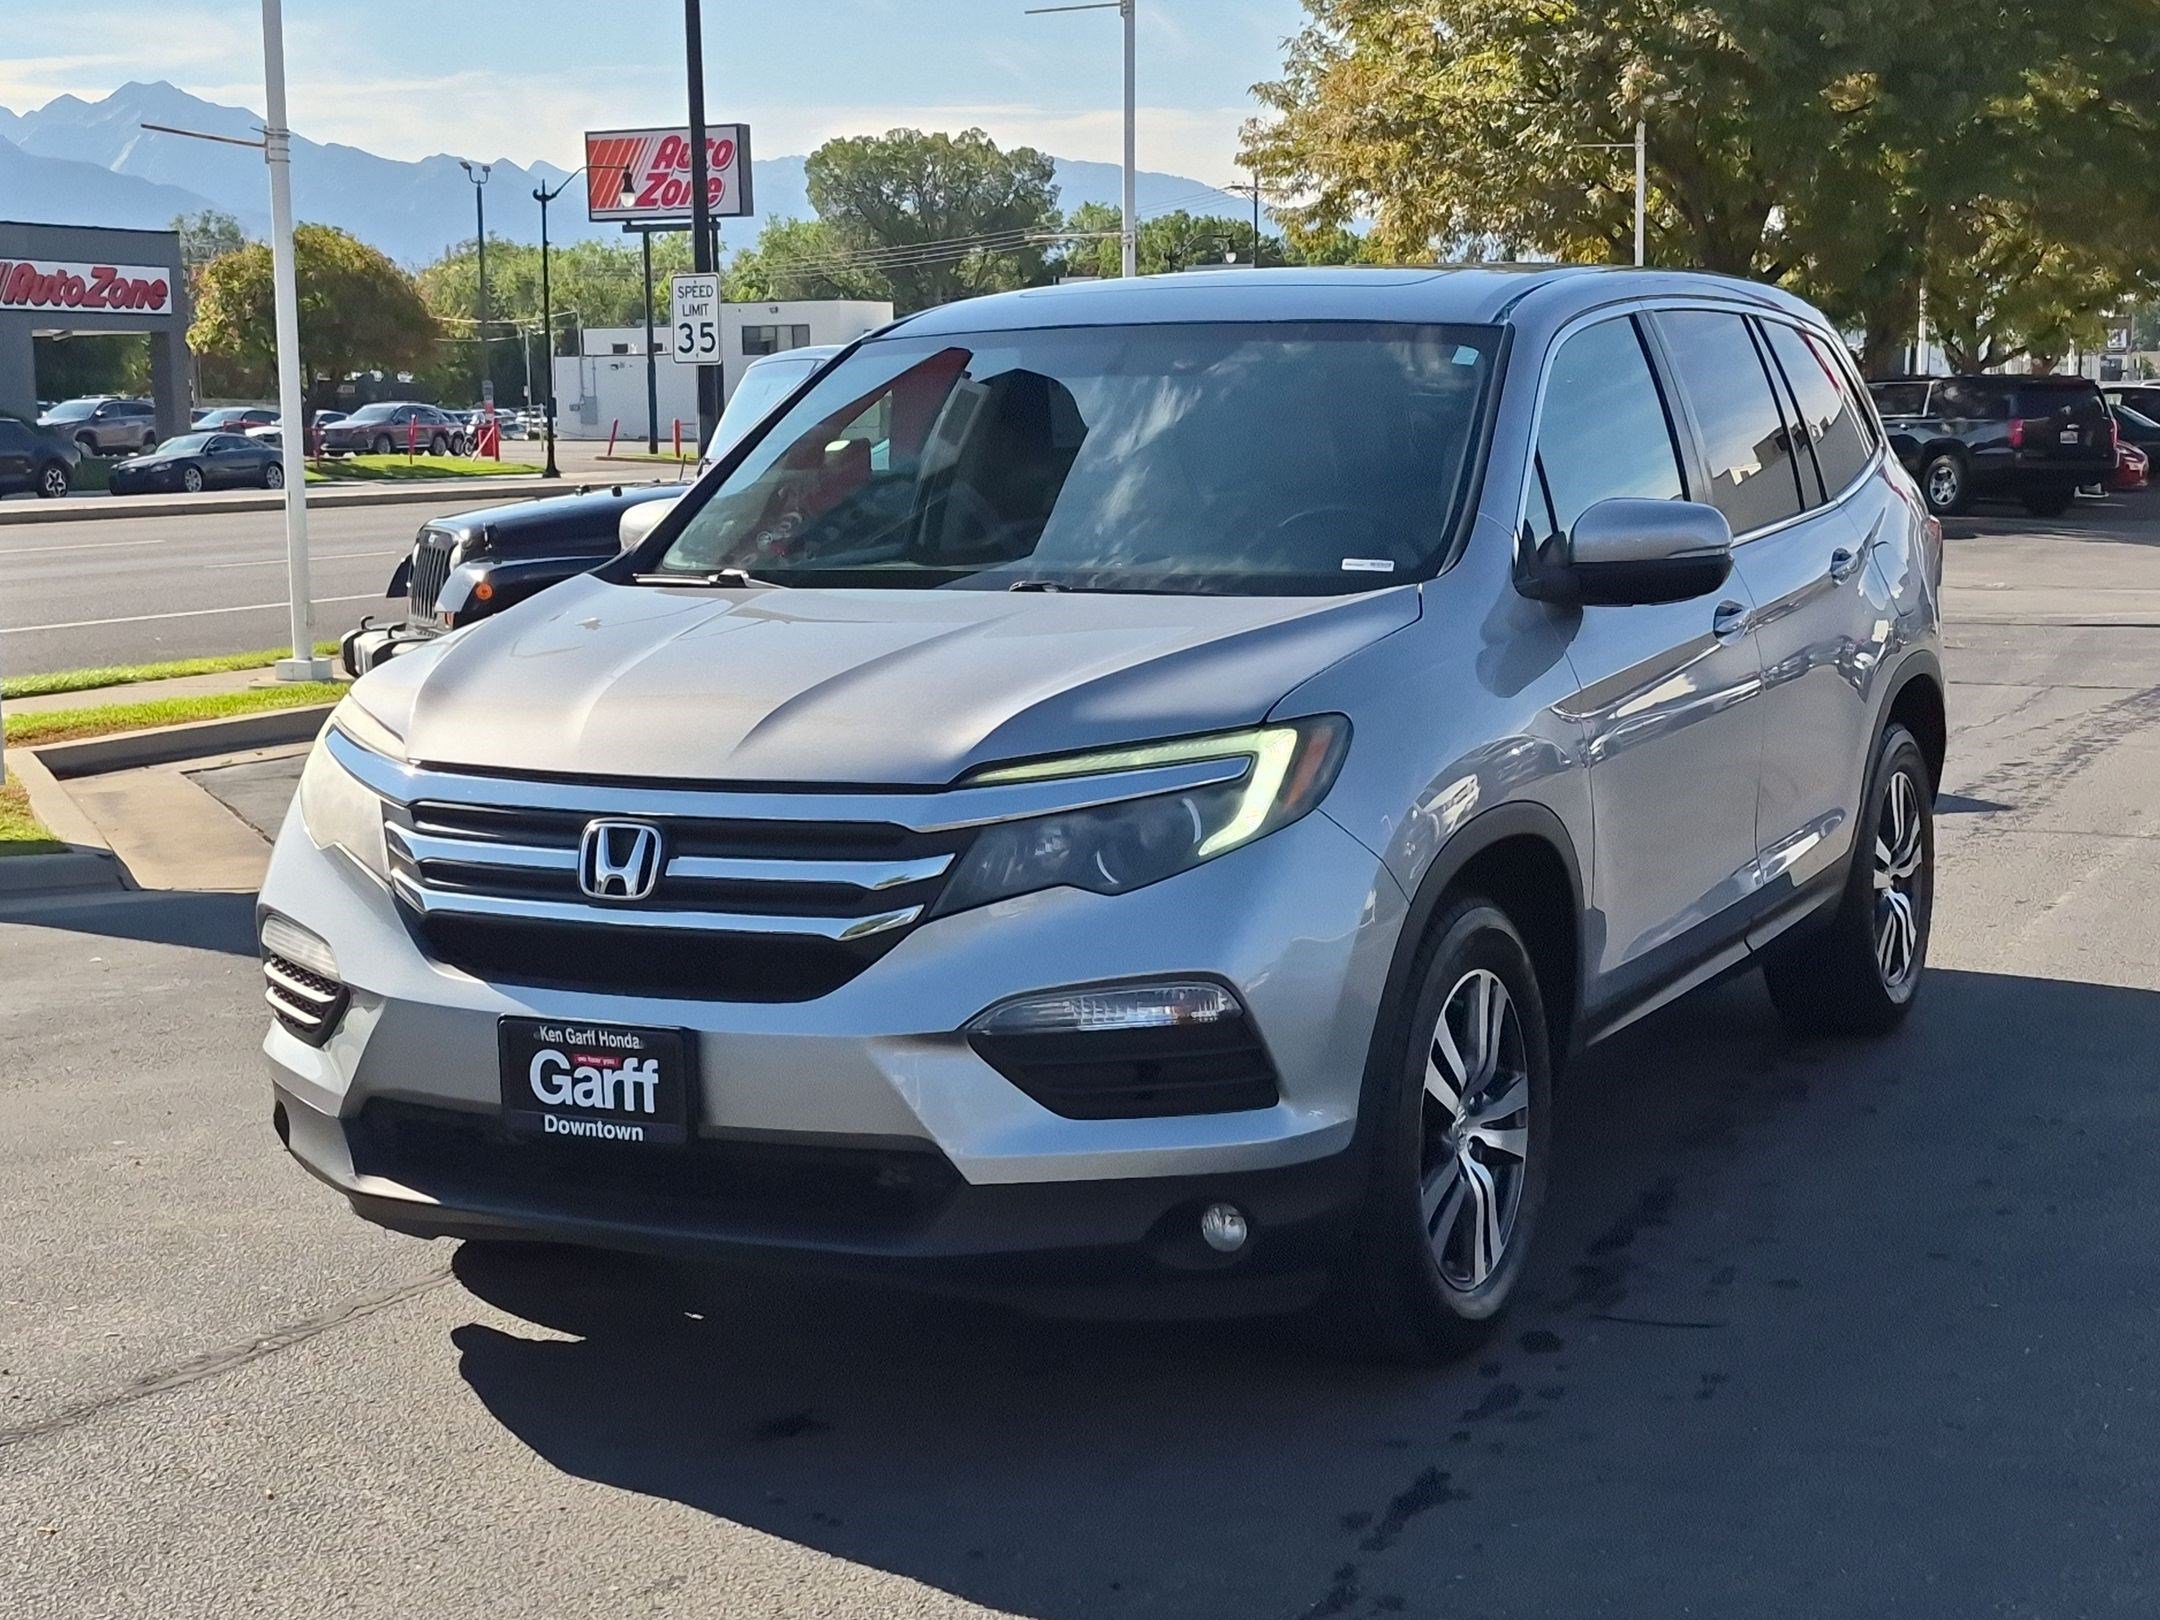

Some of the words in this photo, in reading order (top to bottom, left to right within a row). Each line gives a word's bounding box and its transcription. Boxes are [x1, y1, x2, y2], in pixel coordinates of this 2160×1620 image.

[3, 263, 168, 310] AutoZone
[677, 285, 714, 299] SPEED
[682, 303, 709, 317] LIMIT
[678, 322, 716, 354] 35
[539, 1025, 563, 1043] Ken
[565, 1027, 596, 1046] Garff
[599, 1031, 641, 1049] Honda
[530, 1049, 658, 1114] Garff
[544, 1114, 643, 1141] Downtown
